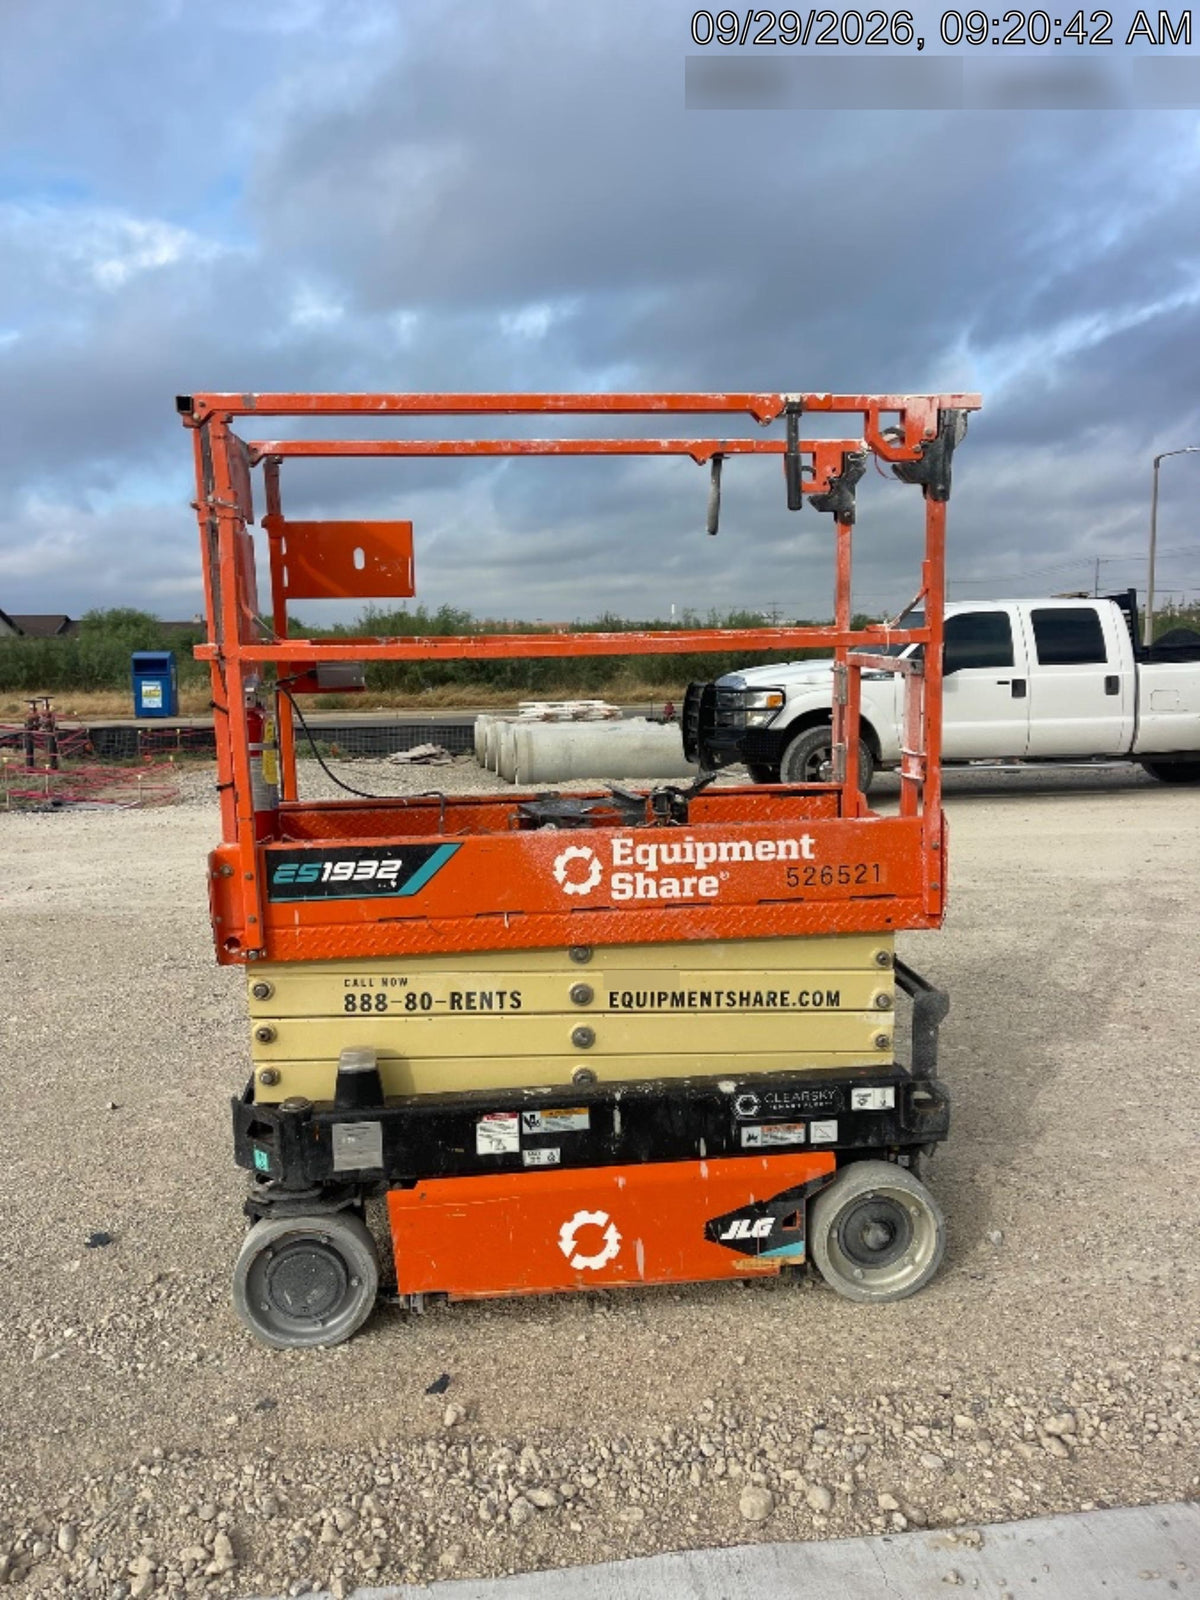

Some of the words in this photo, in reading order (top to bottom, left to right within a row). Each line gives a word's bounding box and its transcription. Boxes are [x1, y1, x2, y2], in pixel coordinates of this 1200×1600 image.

[611, 833, 816, 872] Equipment
[273, 860, 402, 884] ES1932
[786, 863, 882, 888] 526521
[344, 979, 375, 987] CALL
[381, 977, 408, 987] NOW
[344, 991, 522, 1012] 888-80-RENTS
[609, 989, 841, 1009] EQUIPMENTSHARE.COM
[764, 1089, 836, 1103] CLEARSKY
[719, 1217, 776, 1240] JLG
